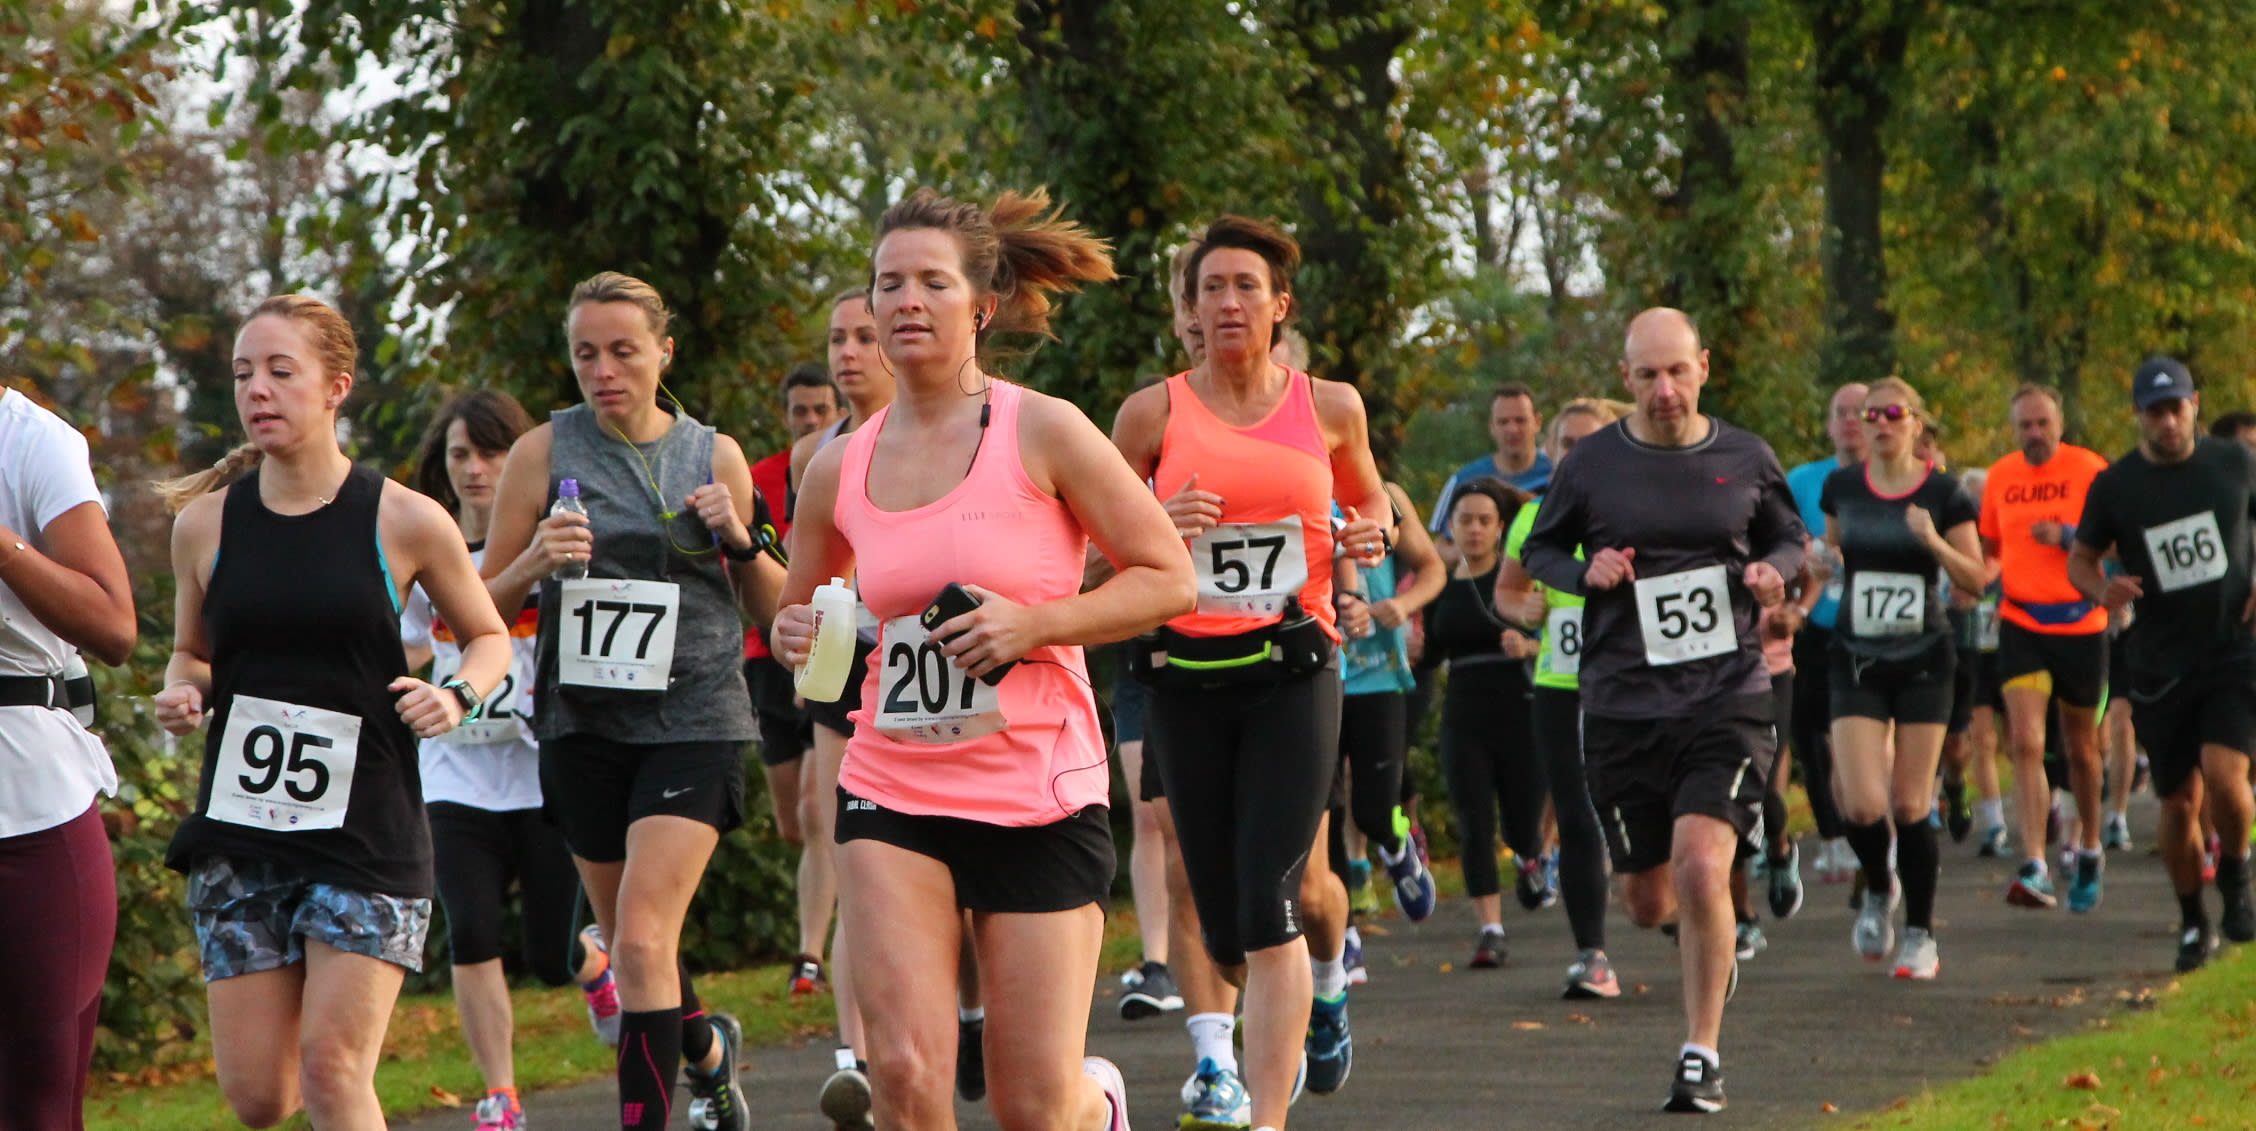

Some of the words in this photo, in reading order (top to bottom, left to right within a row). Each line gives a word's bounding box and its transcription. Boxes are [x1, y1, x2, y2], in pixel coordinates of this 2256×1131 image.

[2004, 481, 2070, 504] GUIDE
[1211, 535, 1286, 593] 57
[2158, 528, 2216, 574] 166
[1656, 587, 1718, 639] 53
[1862, 587, 1917, 620] 172
[573, 600, 667, 659] 177
[1561, 620, 1581, 656] 8
[238, 724, 334, 802] 95
